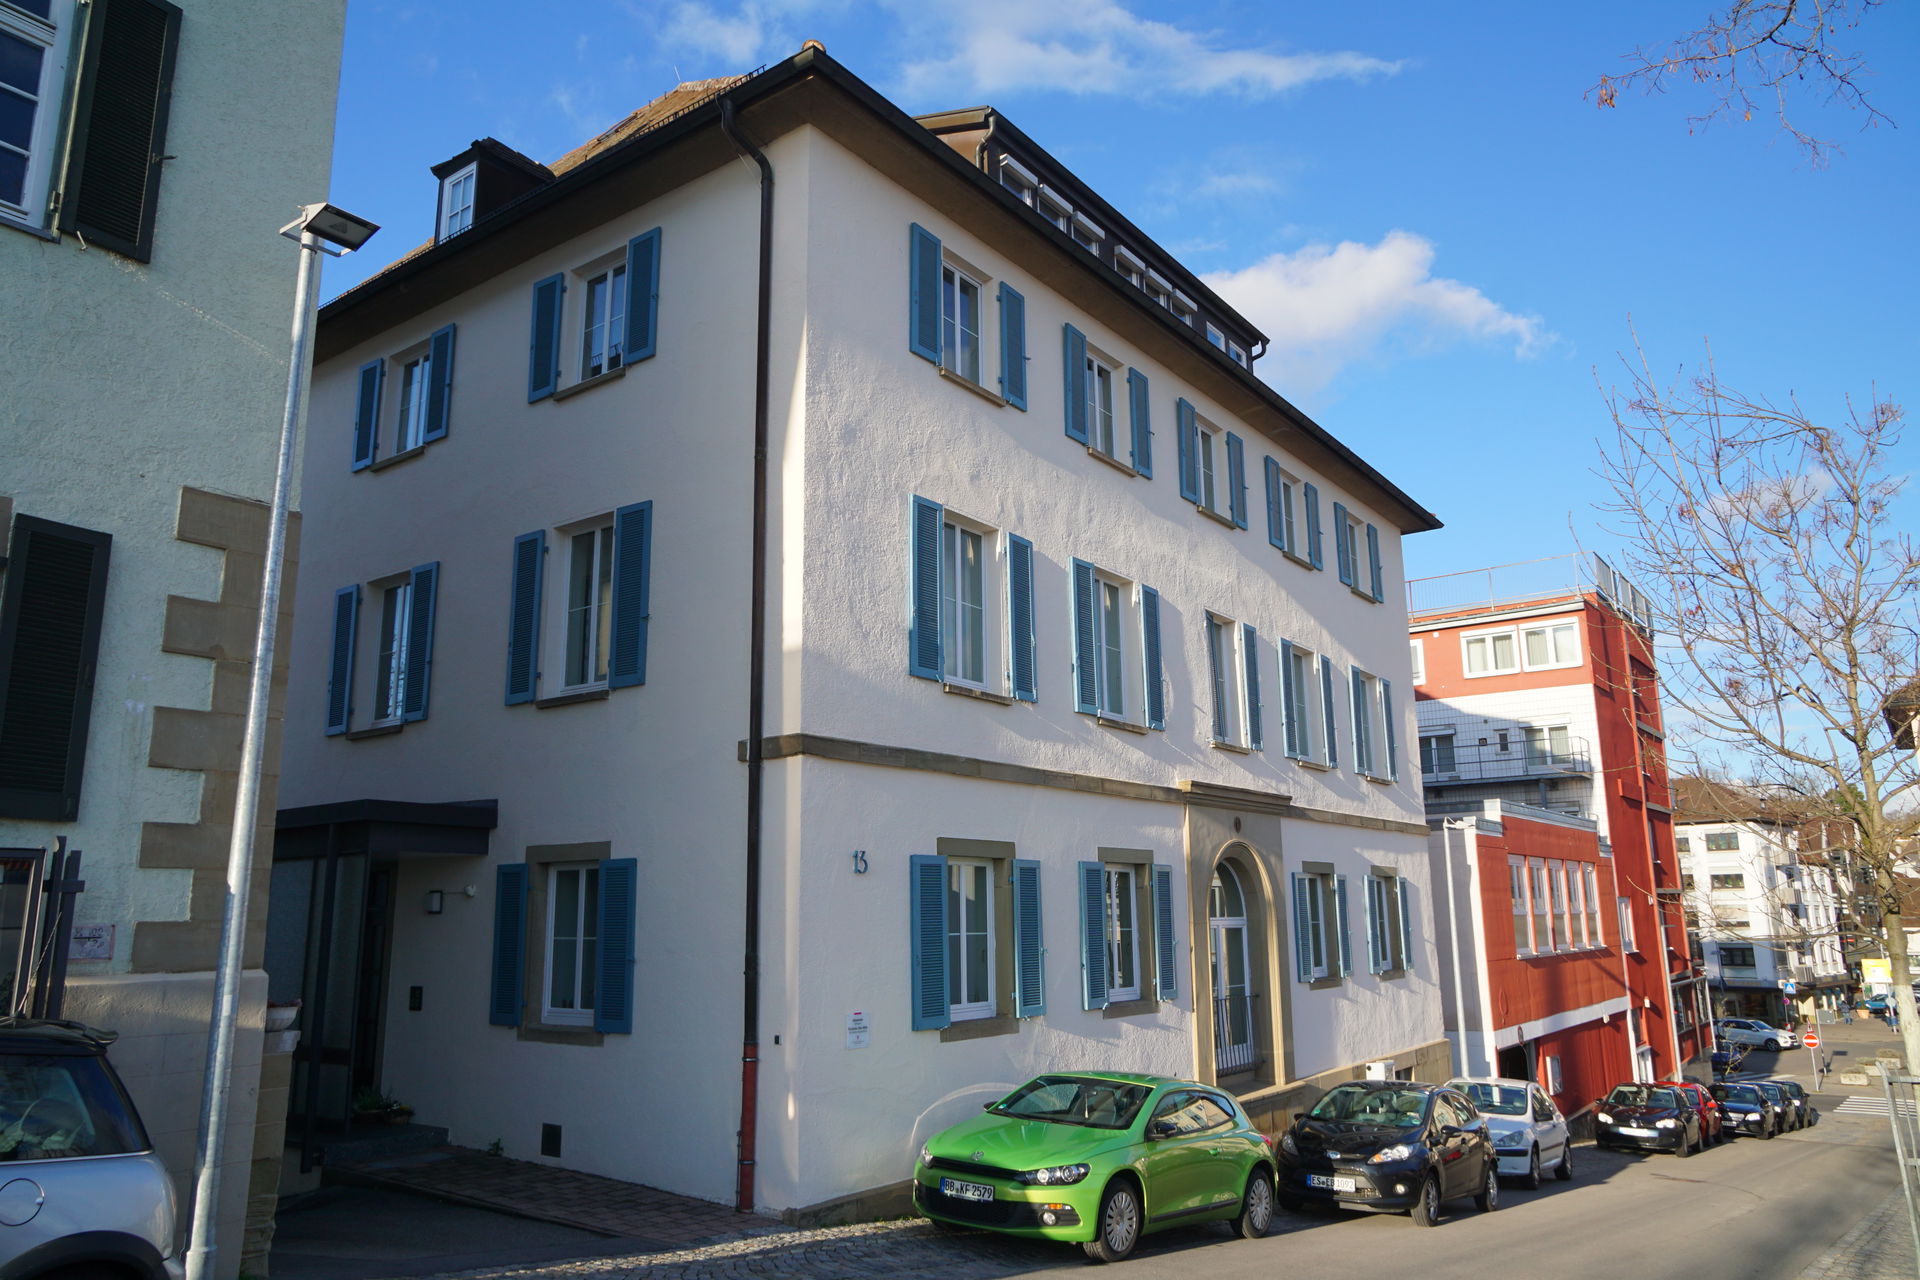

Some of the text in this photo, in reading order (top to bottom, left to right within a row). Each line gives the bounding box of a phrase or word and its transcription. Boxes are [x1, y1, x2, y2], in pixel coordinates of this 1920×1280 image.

[853, 850, 869, 874] 13
[945, 1180, 993, 1199] BB KF 2579
[1311, 1176, 1321, 1186] ES
